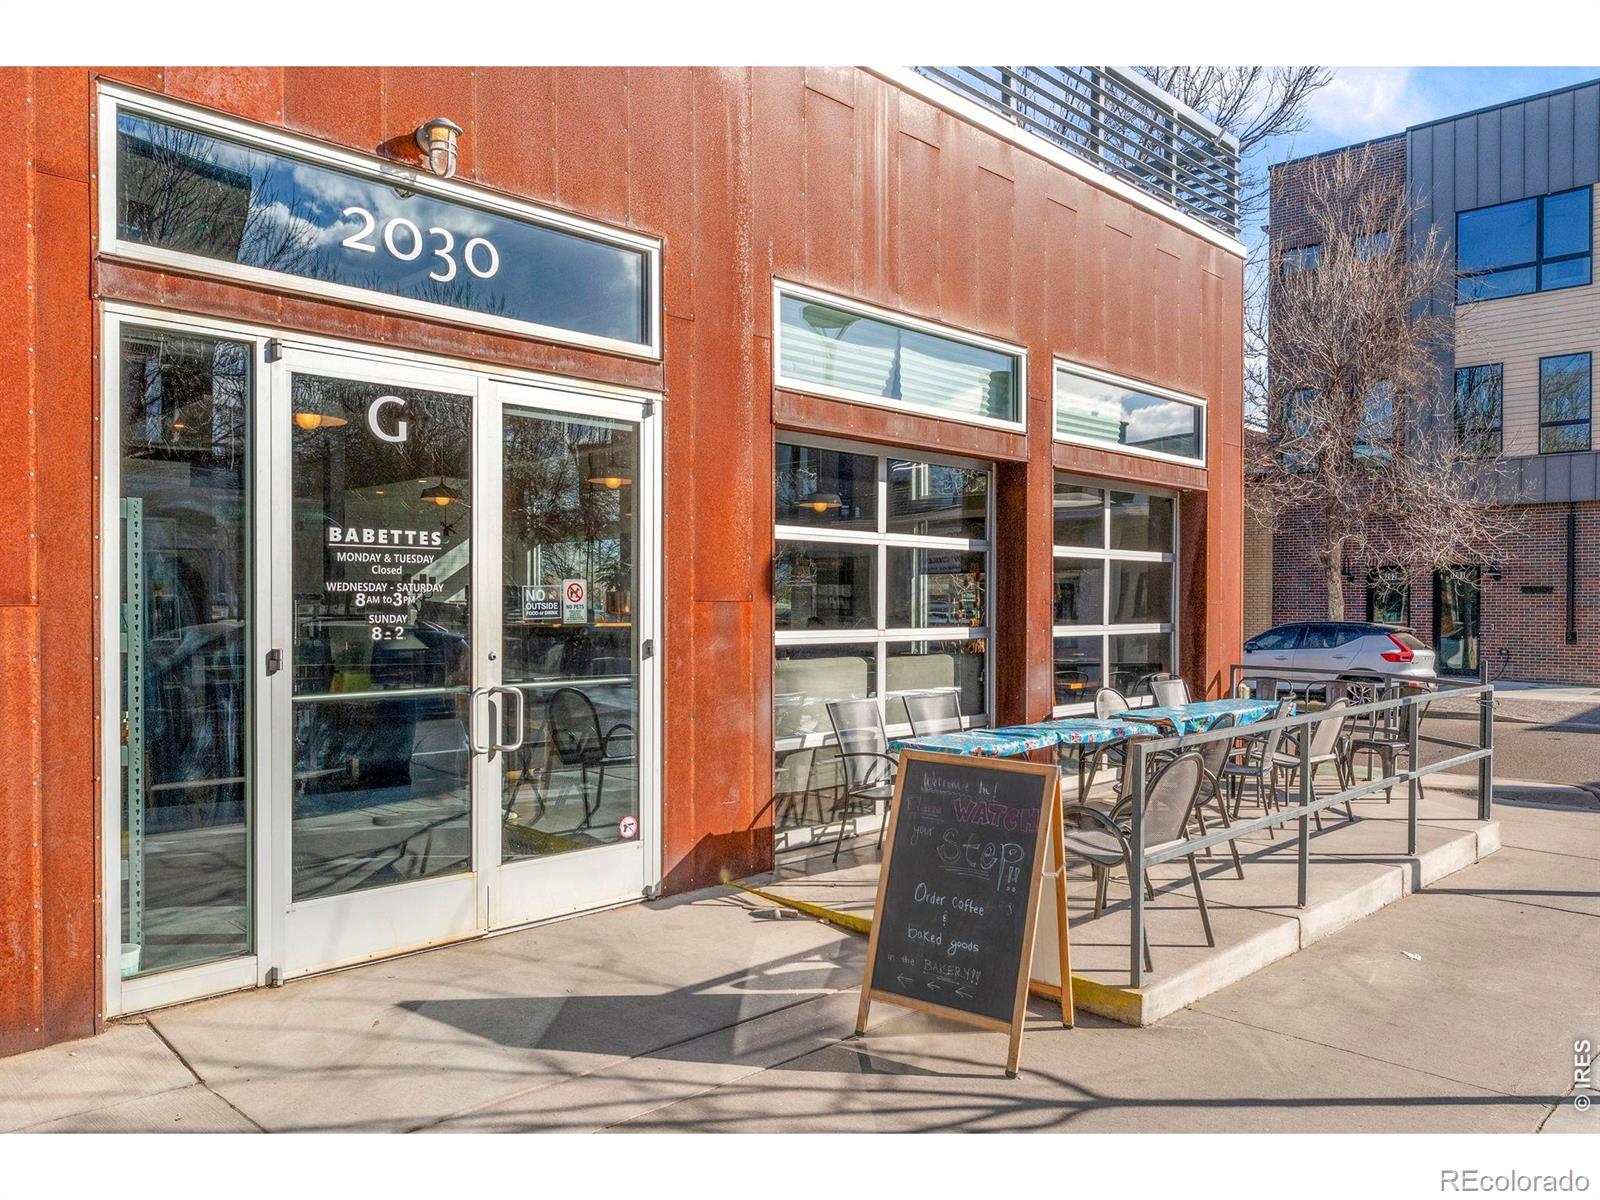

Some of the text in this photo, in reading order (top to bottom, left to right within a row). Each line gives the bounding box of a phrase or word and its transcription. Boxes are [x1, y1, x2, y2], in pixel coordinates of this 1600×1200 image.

[342, 206, 499, 282] 2030
[368, 395, 408, 442] G
[329, 527, 441, 546] BABETTES
[336, 552, 435, 563] MONDAY & TUESDAY
[371, 565, 402, 575] Closed
[326, 581, 388, 592] WEDNESDAY
[396, 582, 444, 592] SATURDAY
[525, 589, 546, 601] NO
[525, 602, 558, 610] OUTSIDE
[369, 614, 408, 624] SUNDAY
[953, 798, 1040, 833] WATCH
[910, 825, 935, 847] your
[914, 882, 946, 906] Order
[947, 940, 980, 956] goods
[901, 955, 915, 966] the
